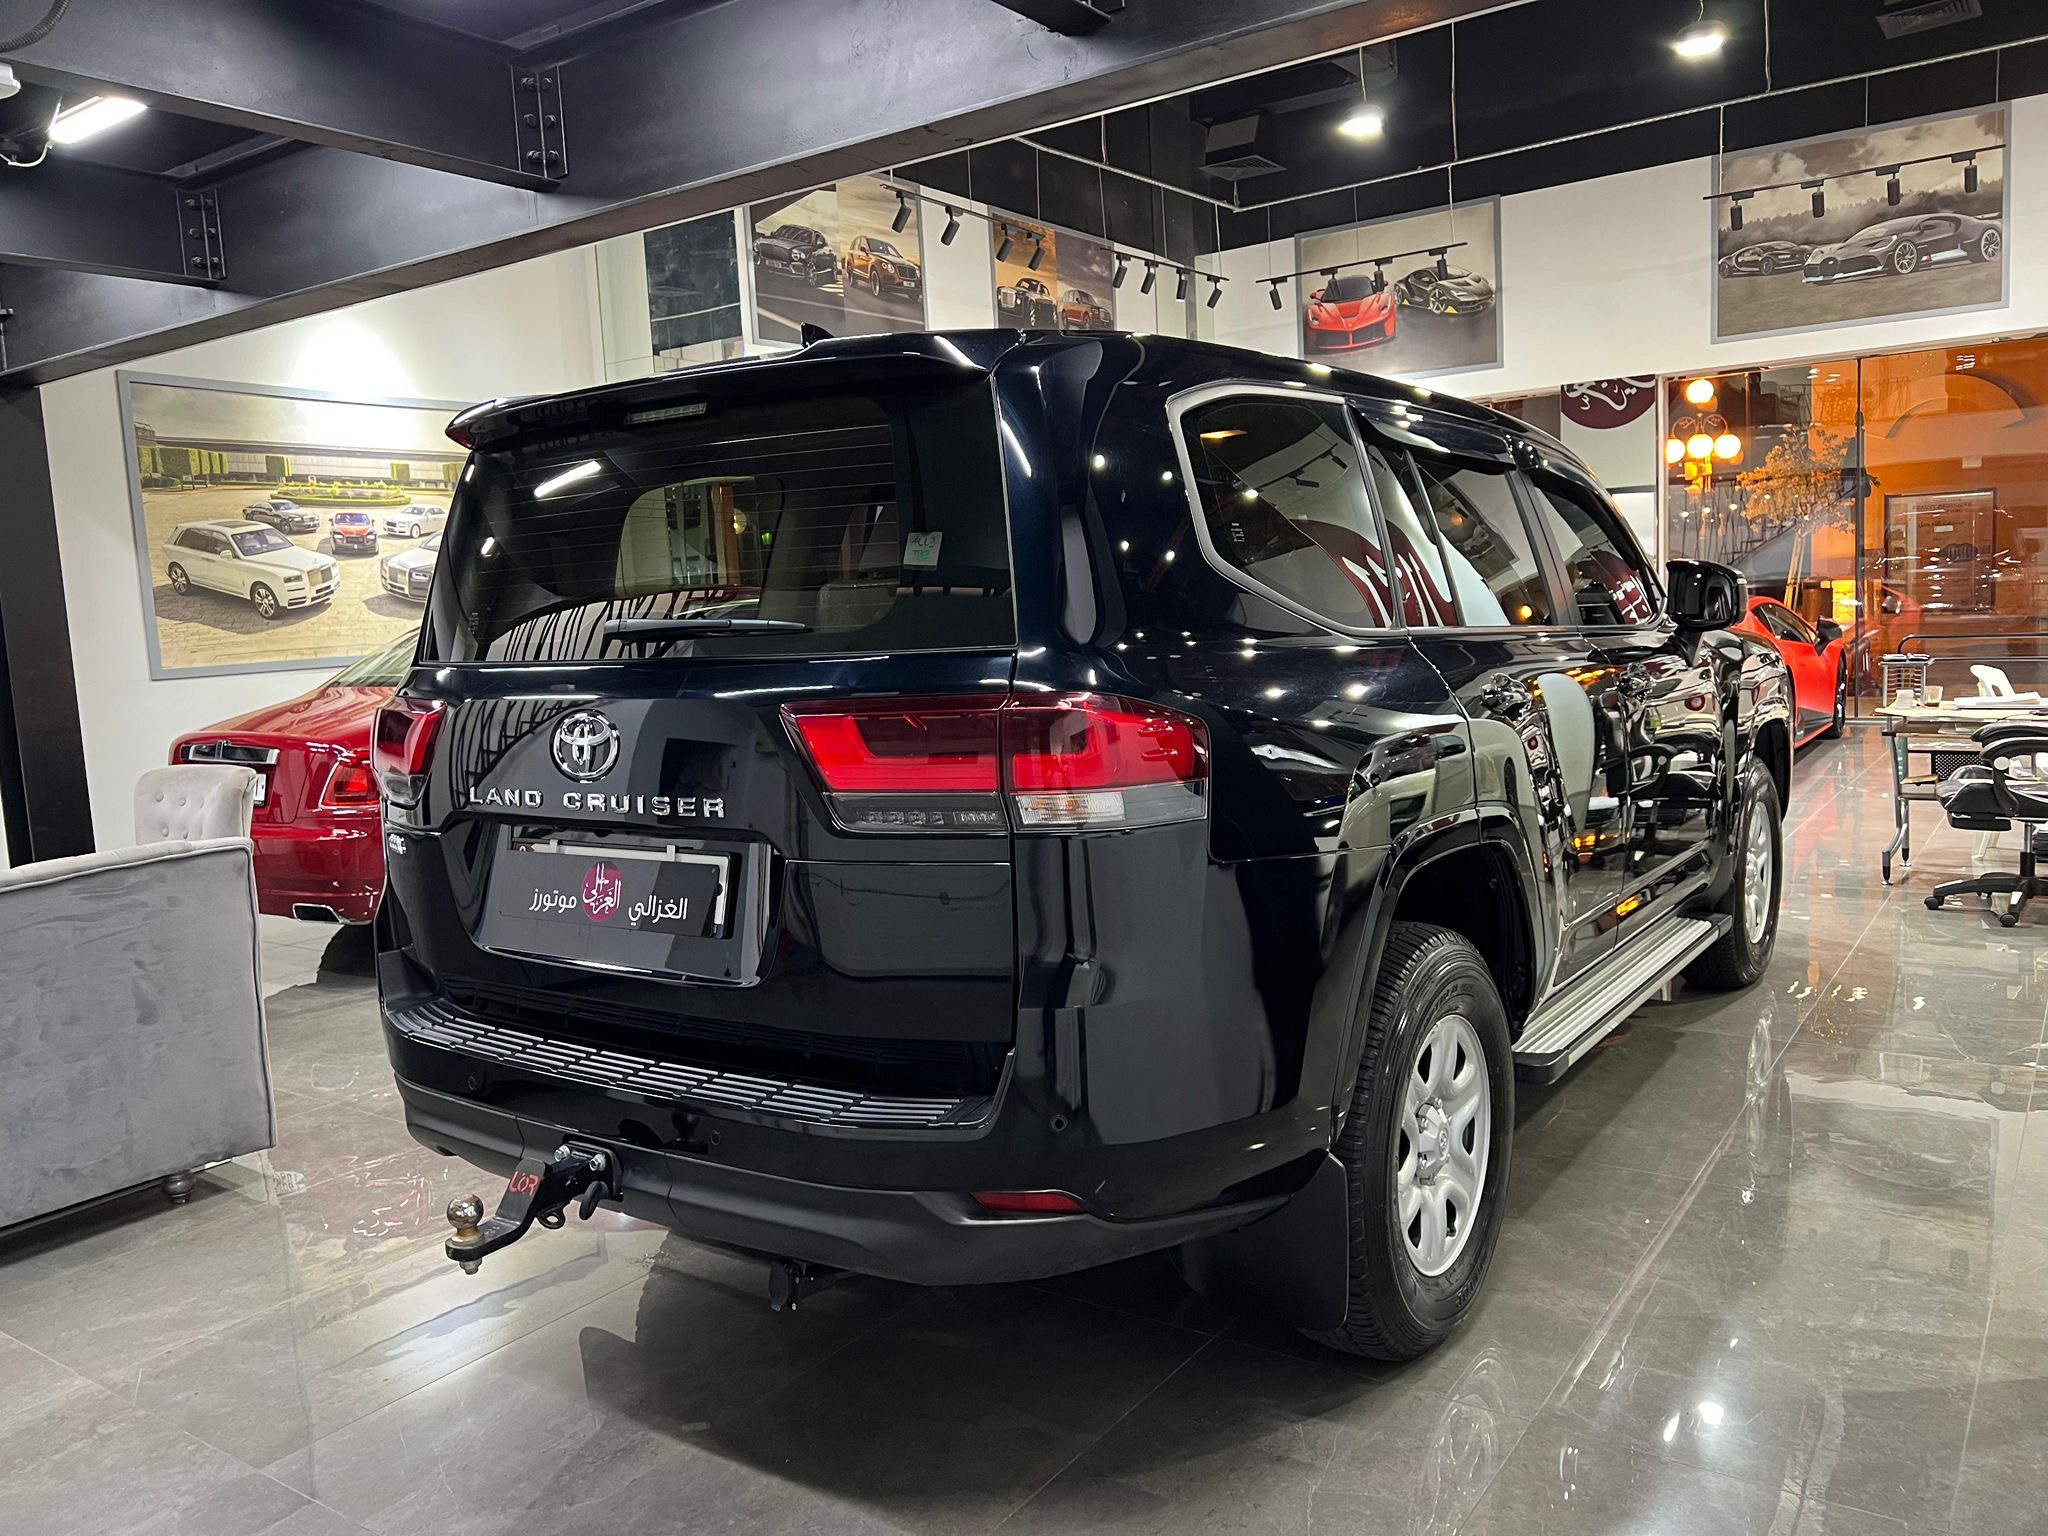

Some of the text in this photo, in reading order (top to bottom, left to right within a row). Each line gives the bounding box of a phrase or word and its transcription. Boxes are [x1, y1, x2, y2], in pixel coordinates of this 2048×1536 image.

[469, 786, 727, 818] LAND CRUISER
[528, 888, 689, 926] الغزالي موتورز
